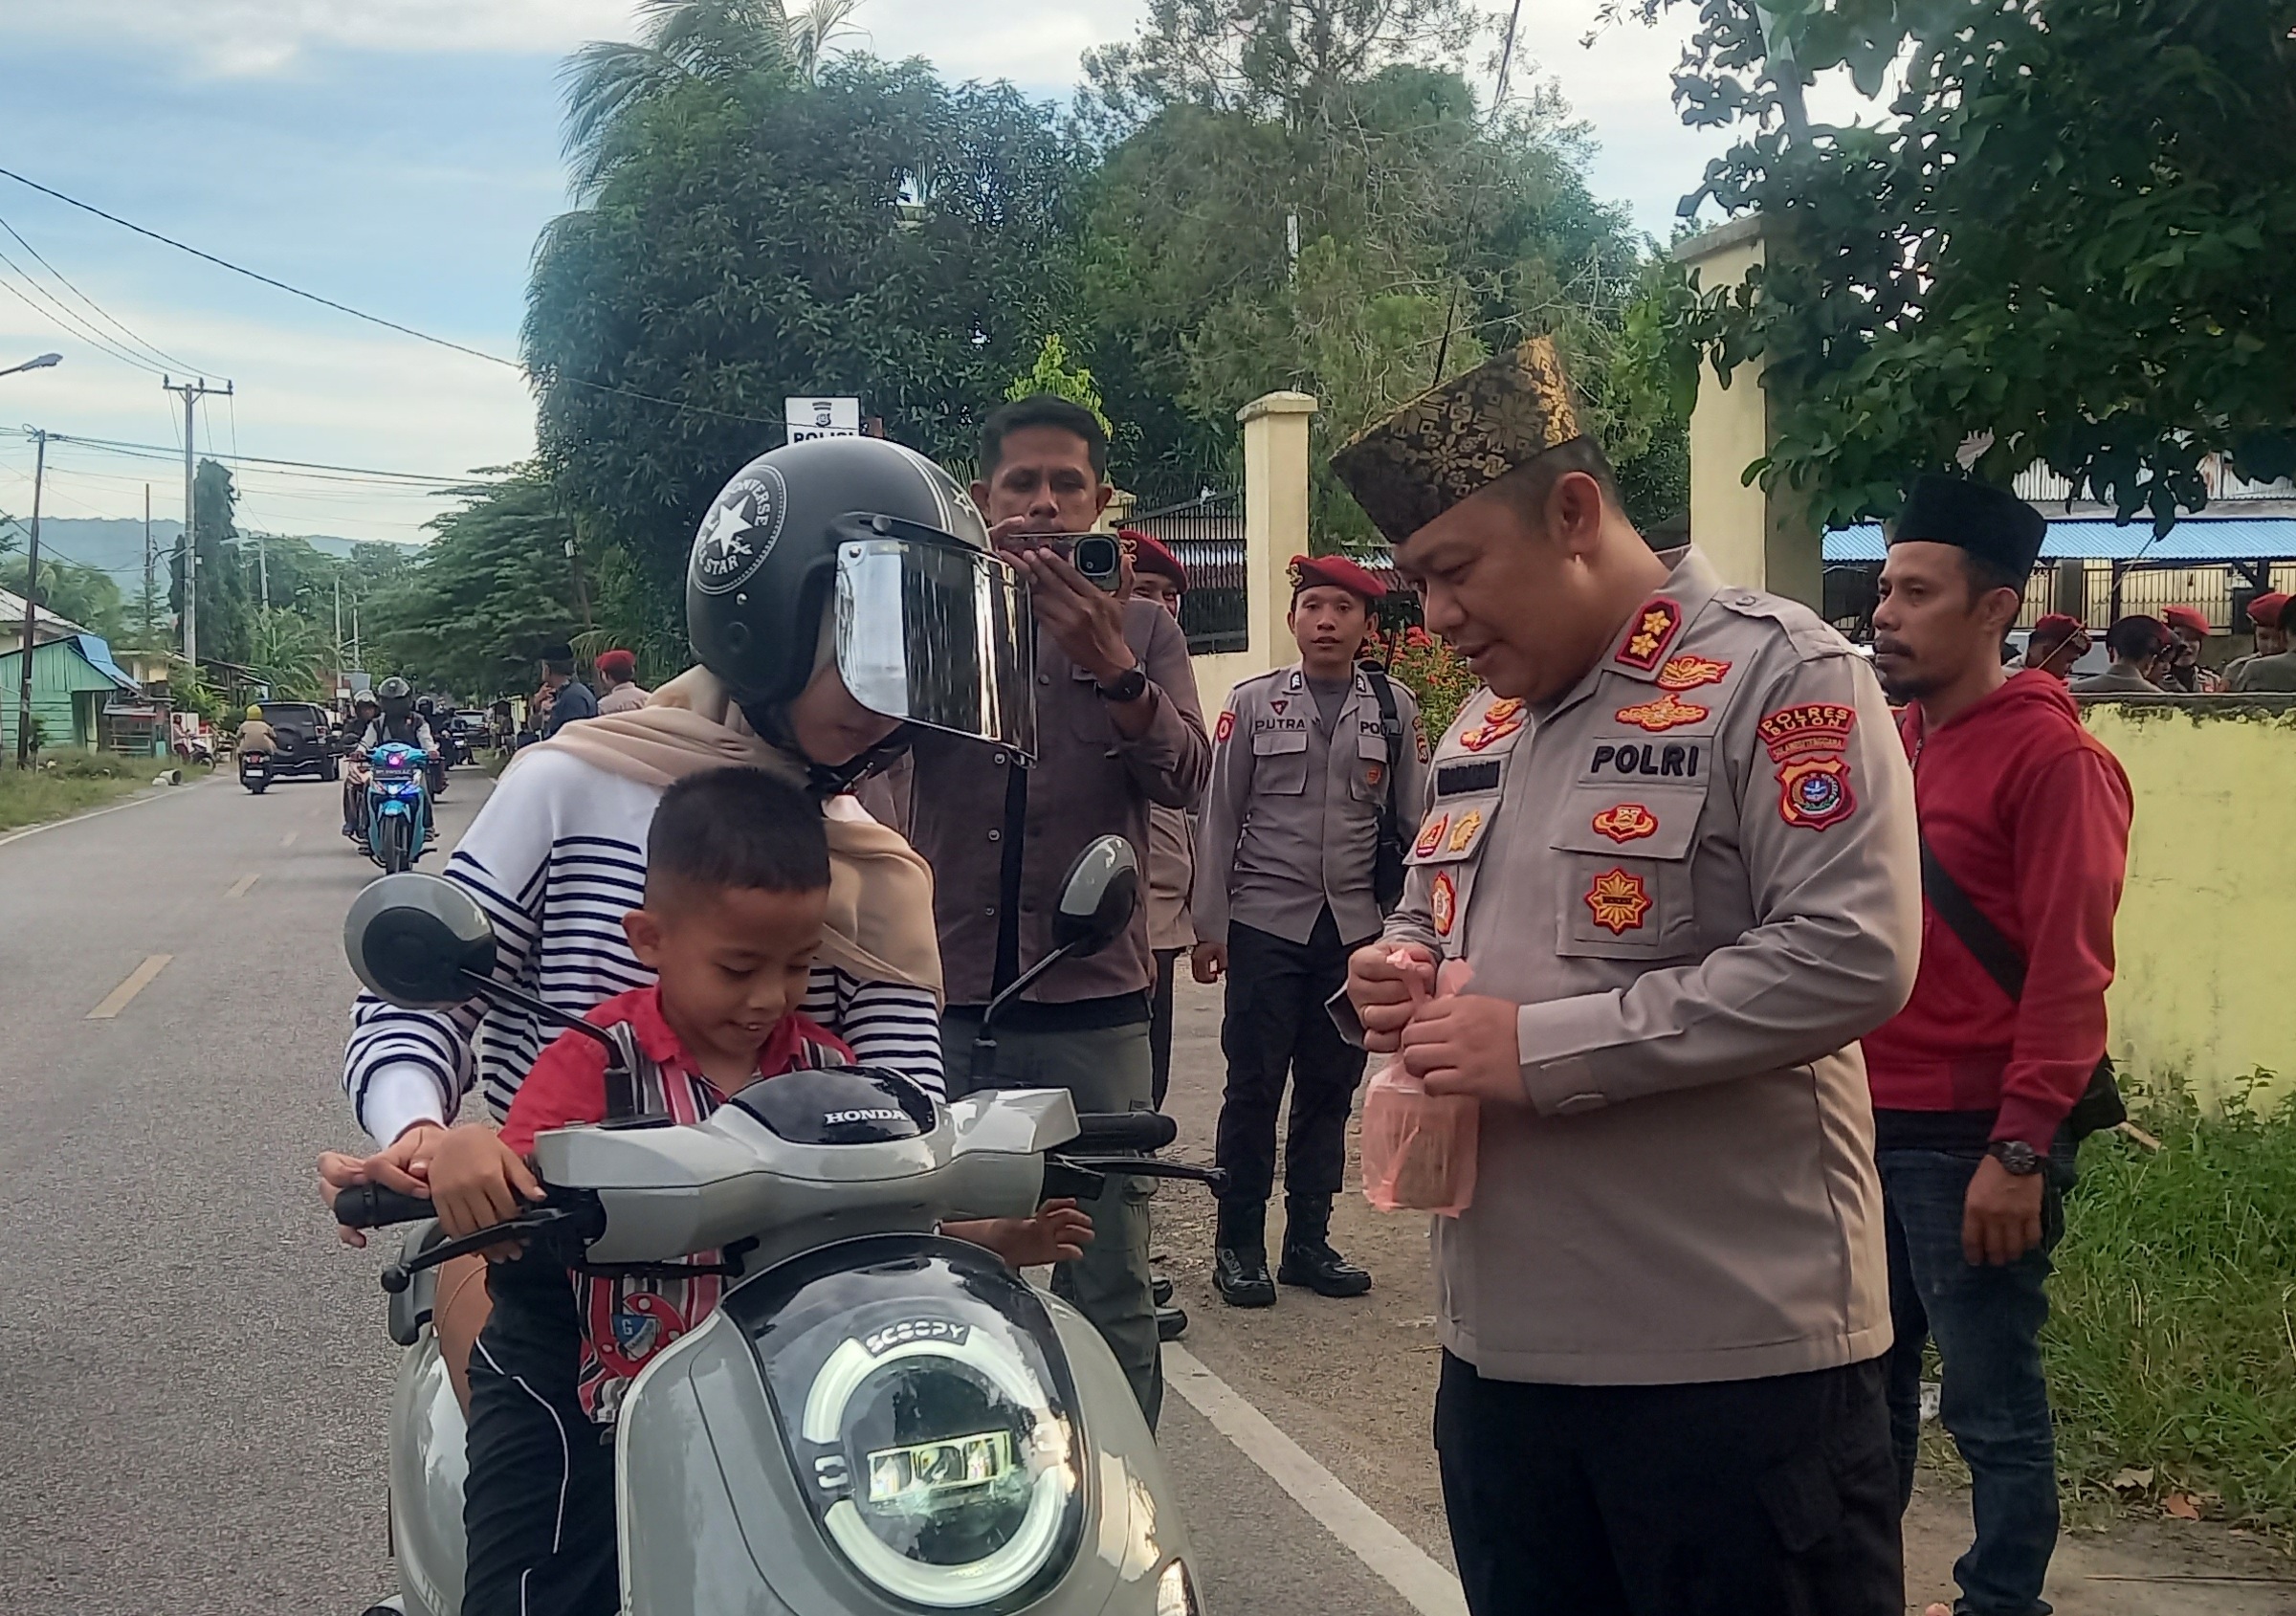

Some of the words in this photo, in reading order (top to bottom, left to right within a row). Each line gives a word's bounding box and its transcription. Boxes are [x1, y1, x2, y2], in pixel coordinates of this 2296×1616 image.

[721, 478, 771, 527] CONVERSE
[703, 554, 740, 575] STAR
[1255, 719, 1306, 731] PUTRA
[1360, 720, 1387, 736] POL
[1761, 707, 1849, 732] POLRES
[1770, 718, 1841, 736] BUTON
[1590, 744, 1700, 777] POLRI
[824, 1109, 910, 1124] HONDA
[622, 1318, 633, 1336] G
[866, 1320, 966, 1353] SCOOPY
